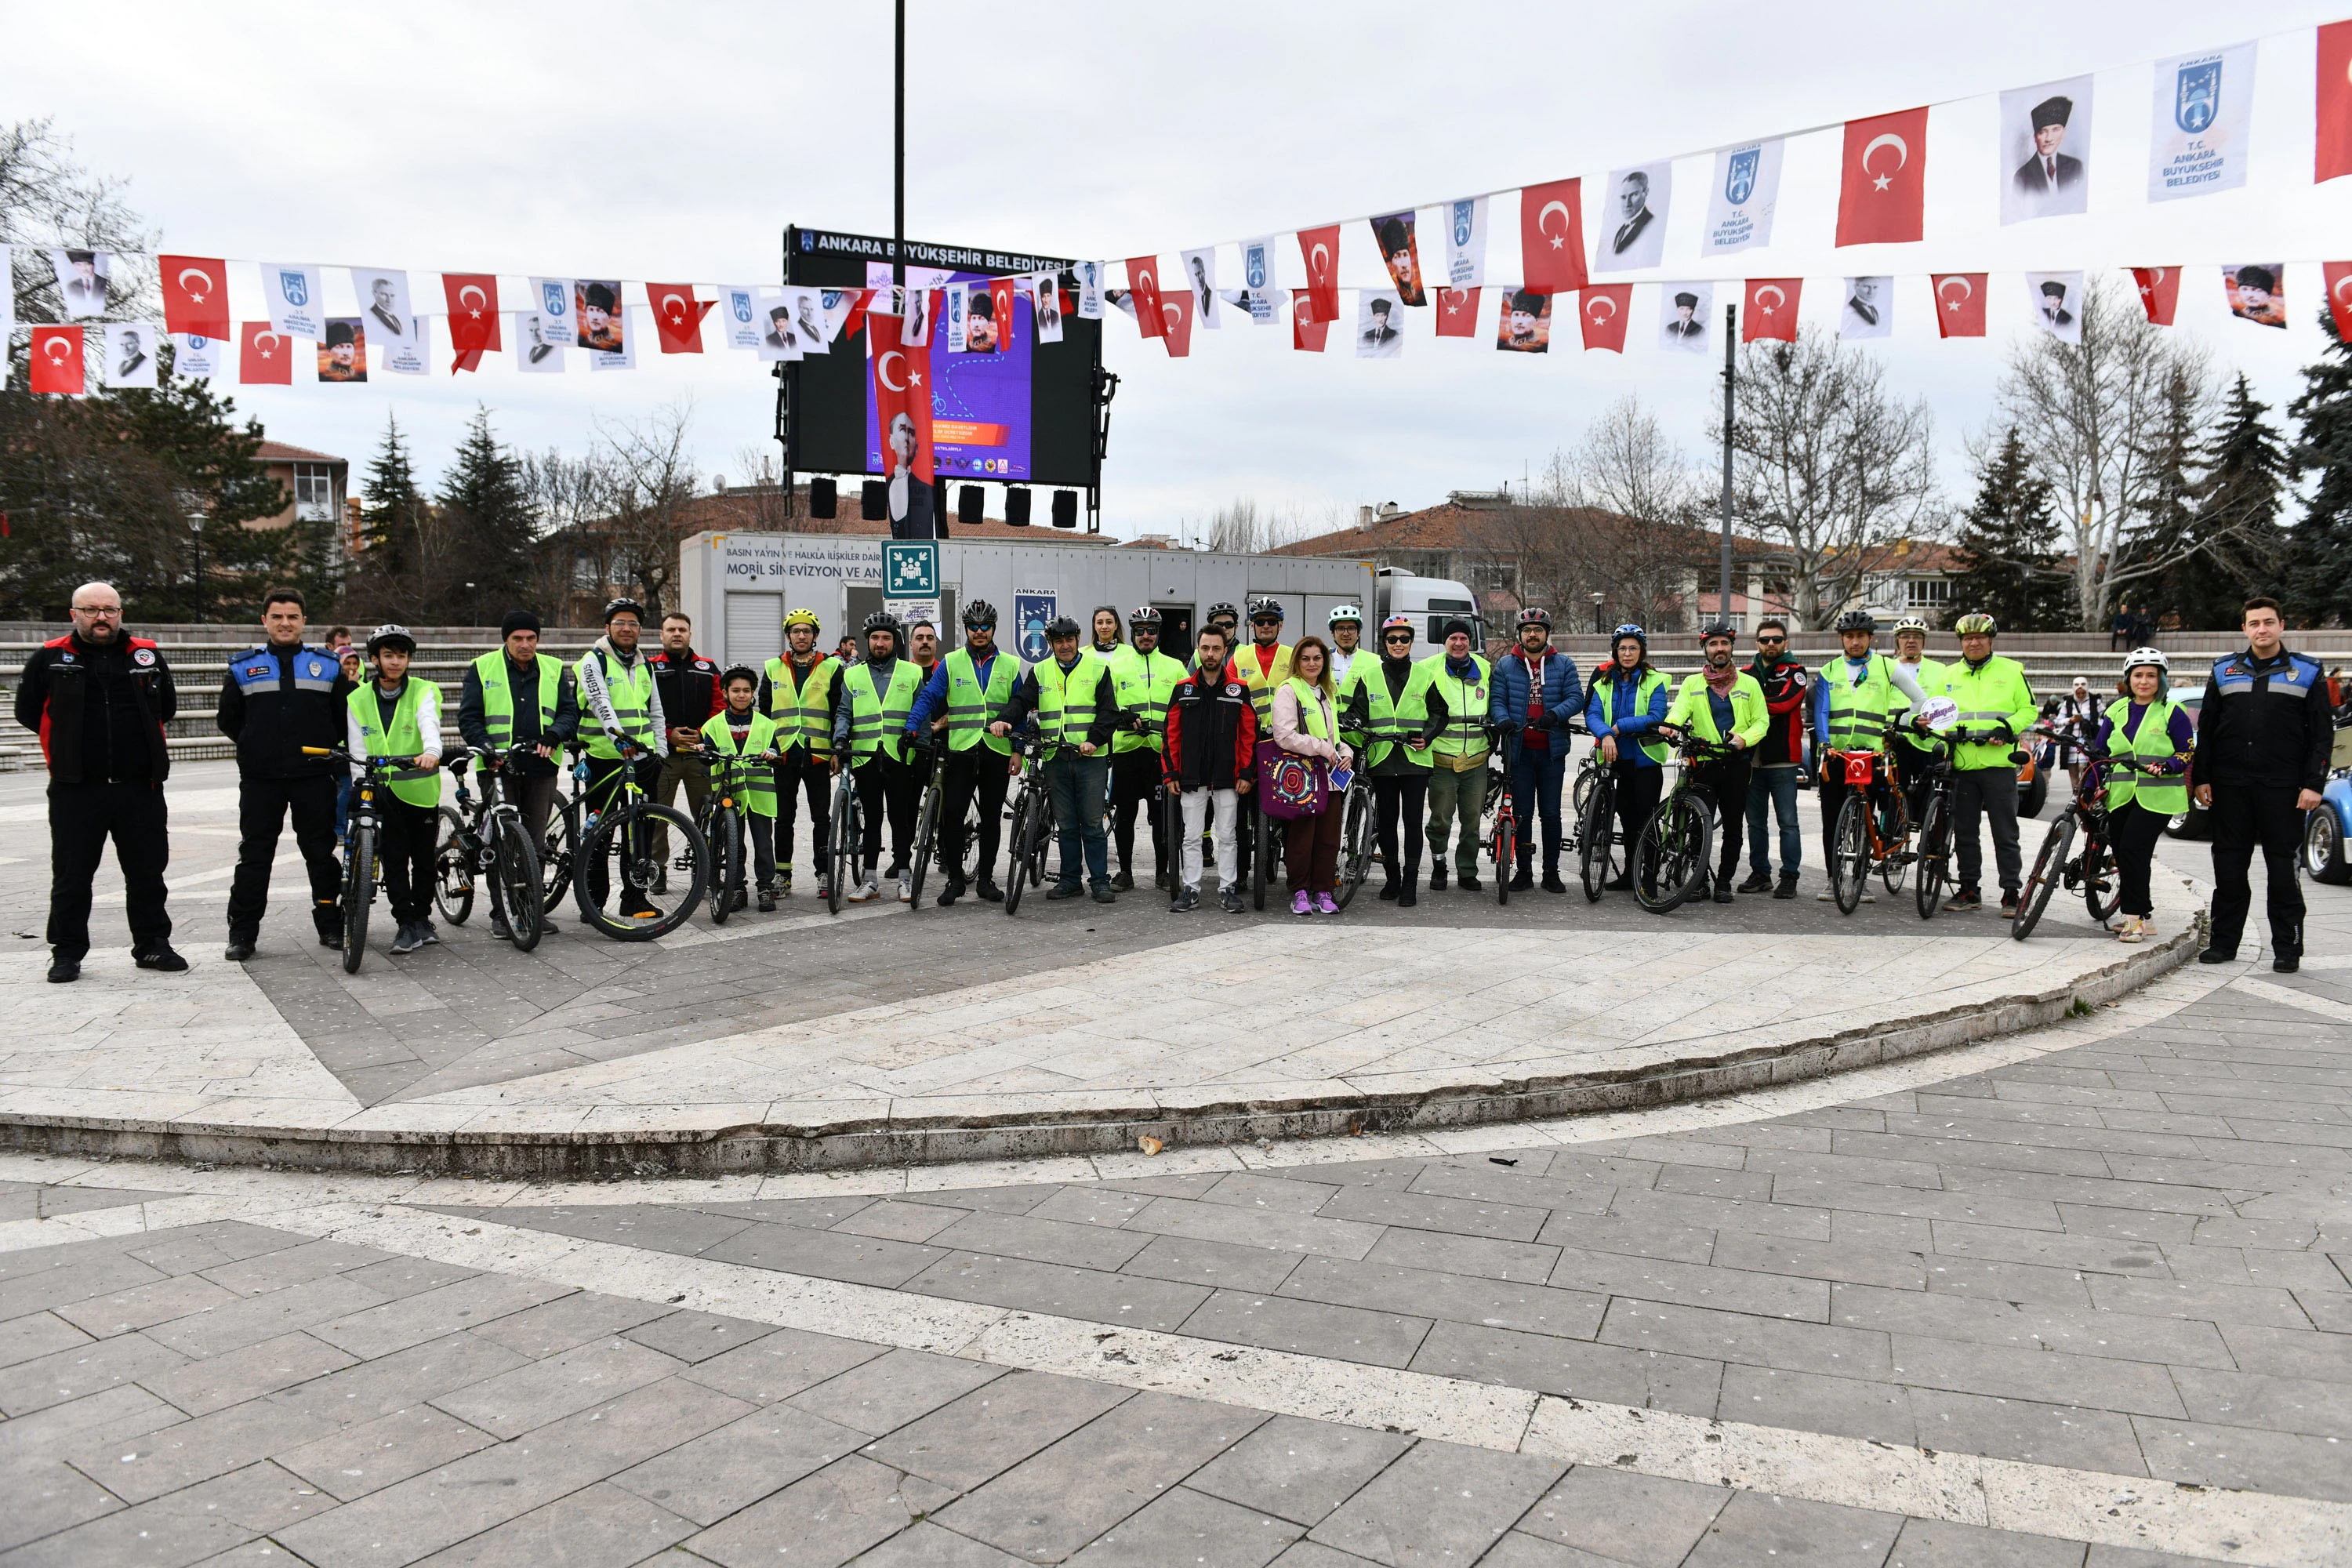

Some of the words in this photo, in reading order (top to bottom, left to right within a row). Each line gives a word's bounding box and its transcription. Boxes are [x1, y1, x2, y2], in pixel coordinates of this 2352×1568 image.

[2178, 54, 2223, 68] ANKARA
[2174, 148, 2216, 164] ANKARA
[1722, 216, 1749, 227] ANKARA
[818, 234, 883, 256] ANKARA
[887, 242, 982, 266] BYÜKŞEHİR
[985, 253, 1066, 276] BELEDİYESİ
[795, 551, 826, 560] HALKLA
[827, 550, 860, 561] İLİŞKİLER
[862, 552, 881, 561] DAİR
[727, 561, 765, 575] MOBİL
[769, 561, 842, 578] SİNEVİZYON
[846, 567, 860, 578] VE
